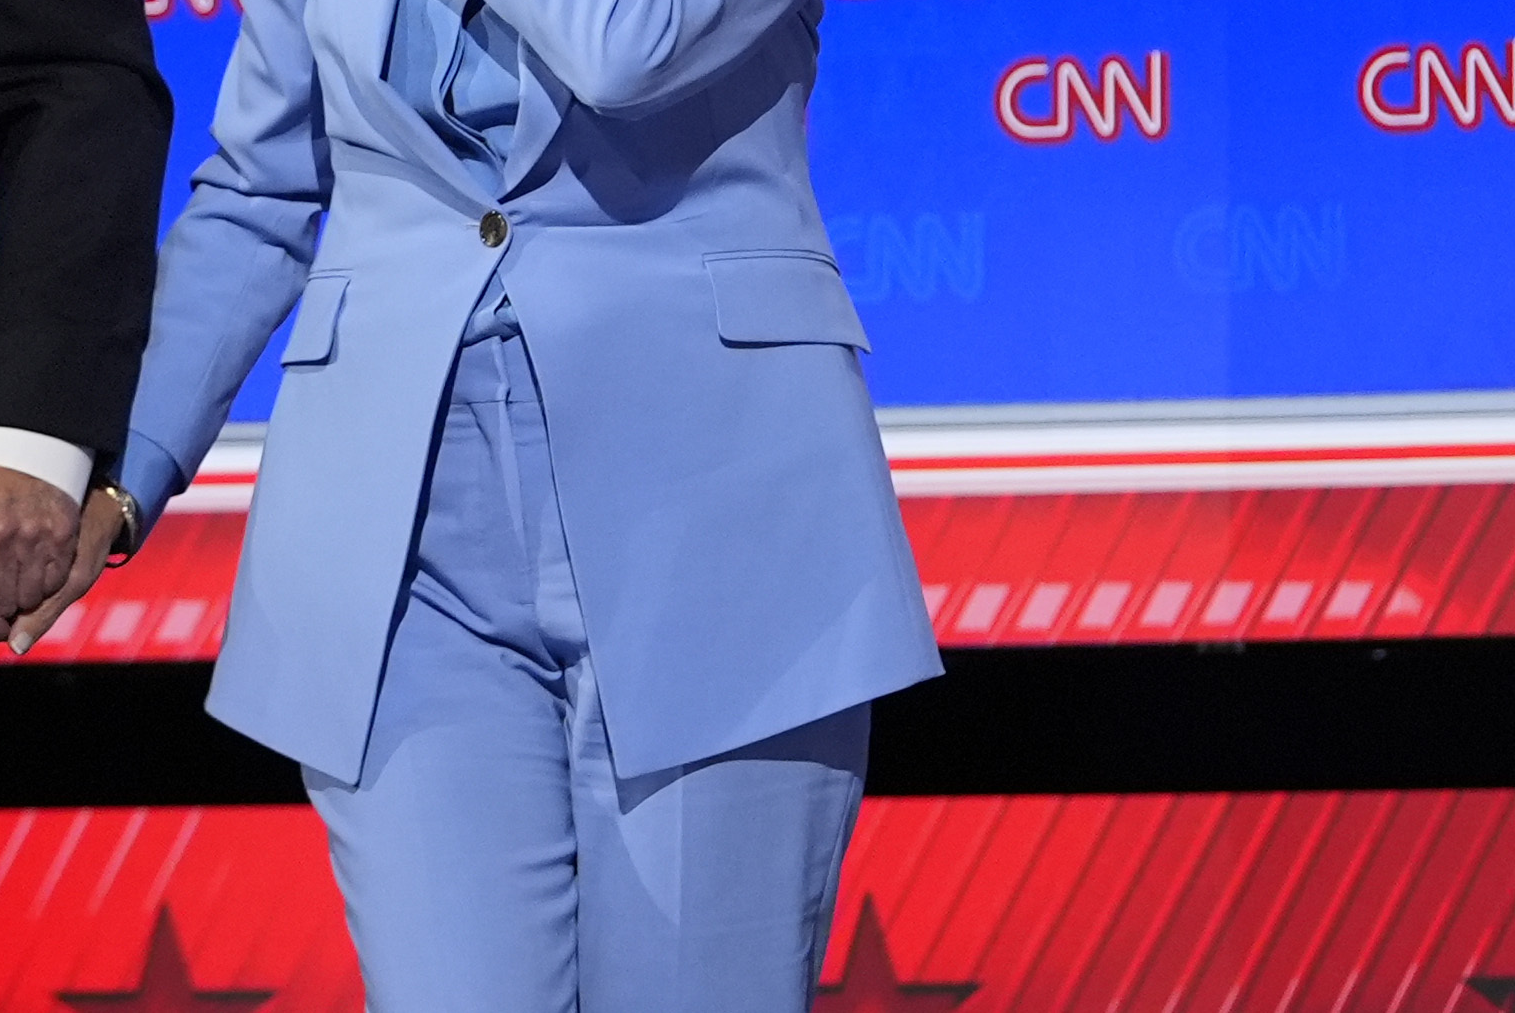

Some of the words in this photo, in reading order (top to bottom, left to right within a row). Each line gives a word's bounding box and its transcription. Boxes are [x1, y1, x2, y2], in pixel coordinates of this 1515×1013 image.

[995, 49, 1168, 142] CNN
[1357, 37, 1515, 132] CNN
[1172, 201, 1347, 295] CNN
